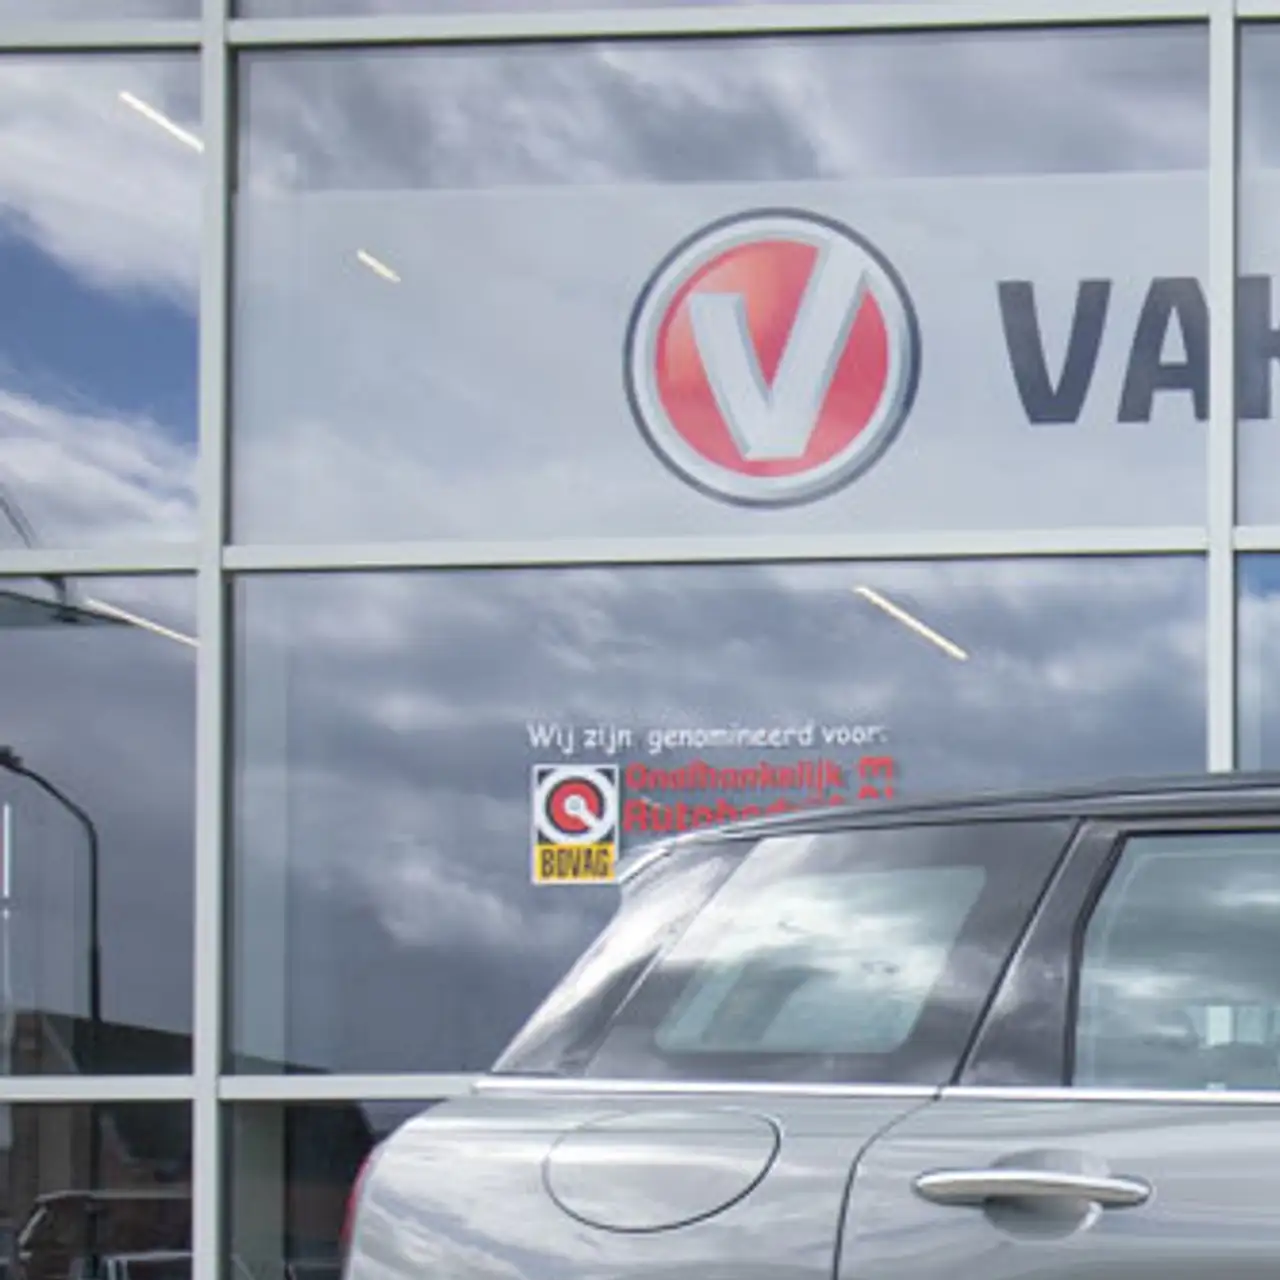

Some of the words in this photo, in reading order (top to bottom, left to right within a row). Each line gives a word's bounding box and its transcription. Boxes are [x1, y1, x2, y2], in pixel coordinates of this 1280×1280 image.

[526, 721, 574, 755] Wij
[583, 724, 632, 755] zijn
[648, 720, 814, 755] genomineerd
[541, 847, 609, 880] BOVAG
